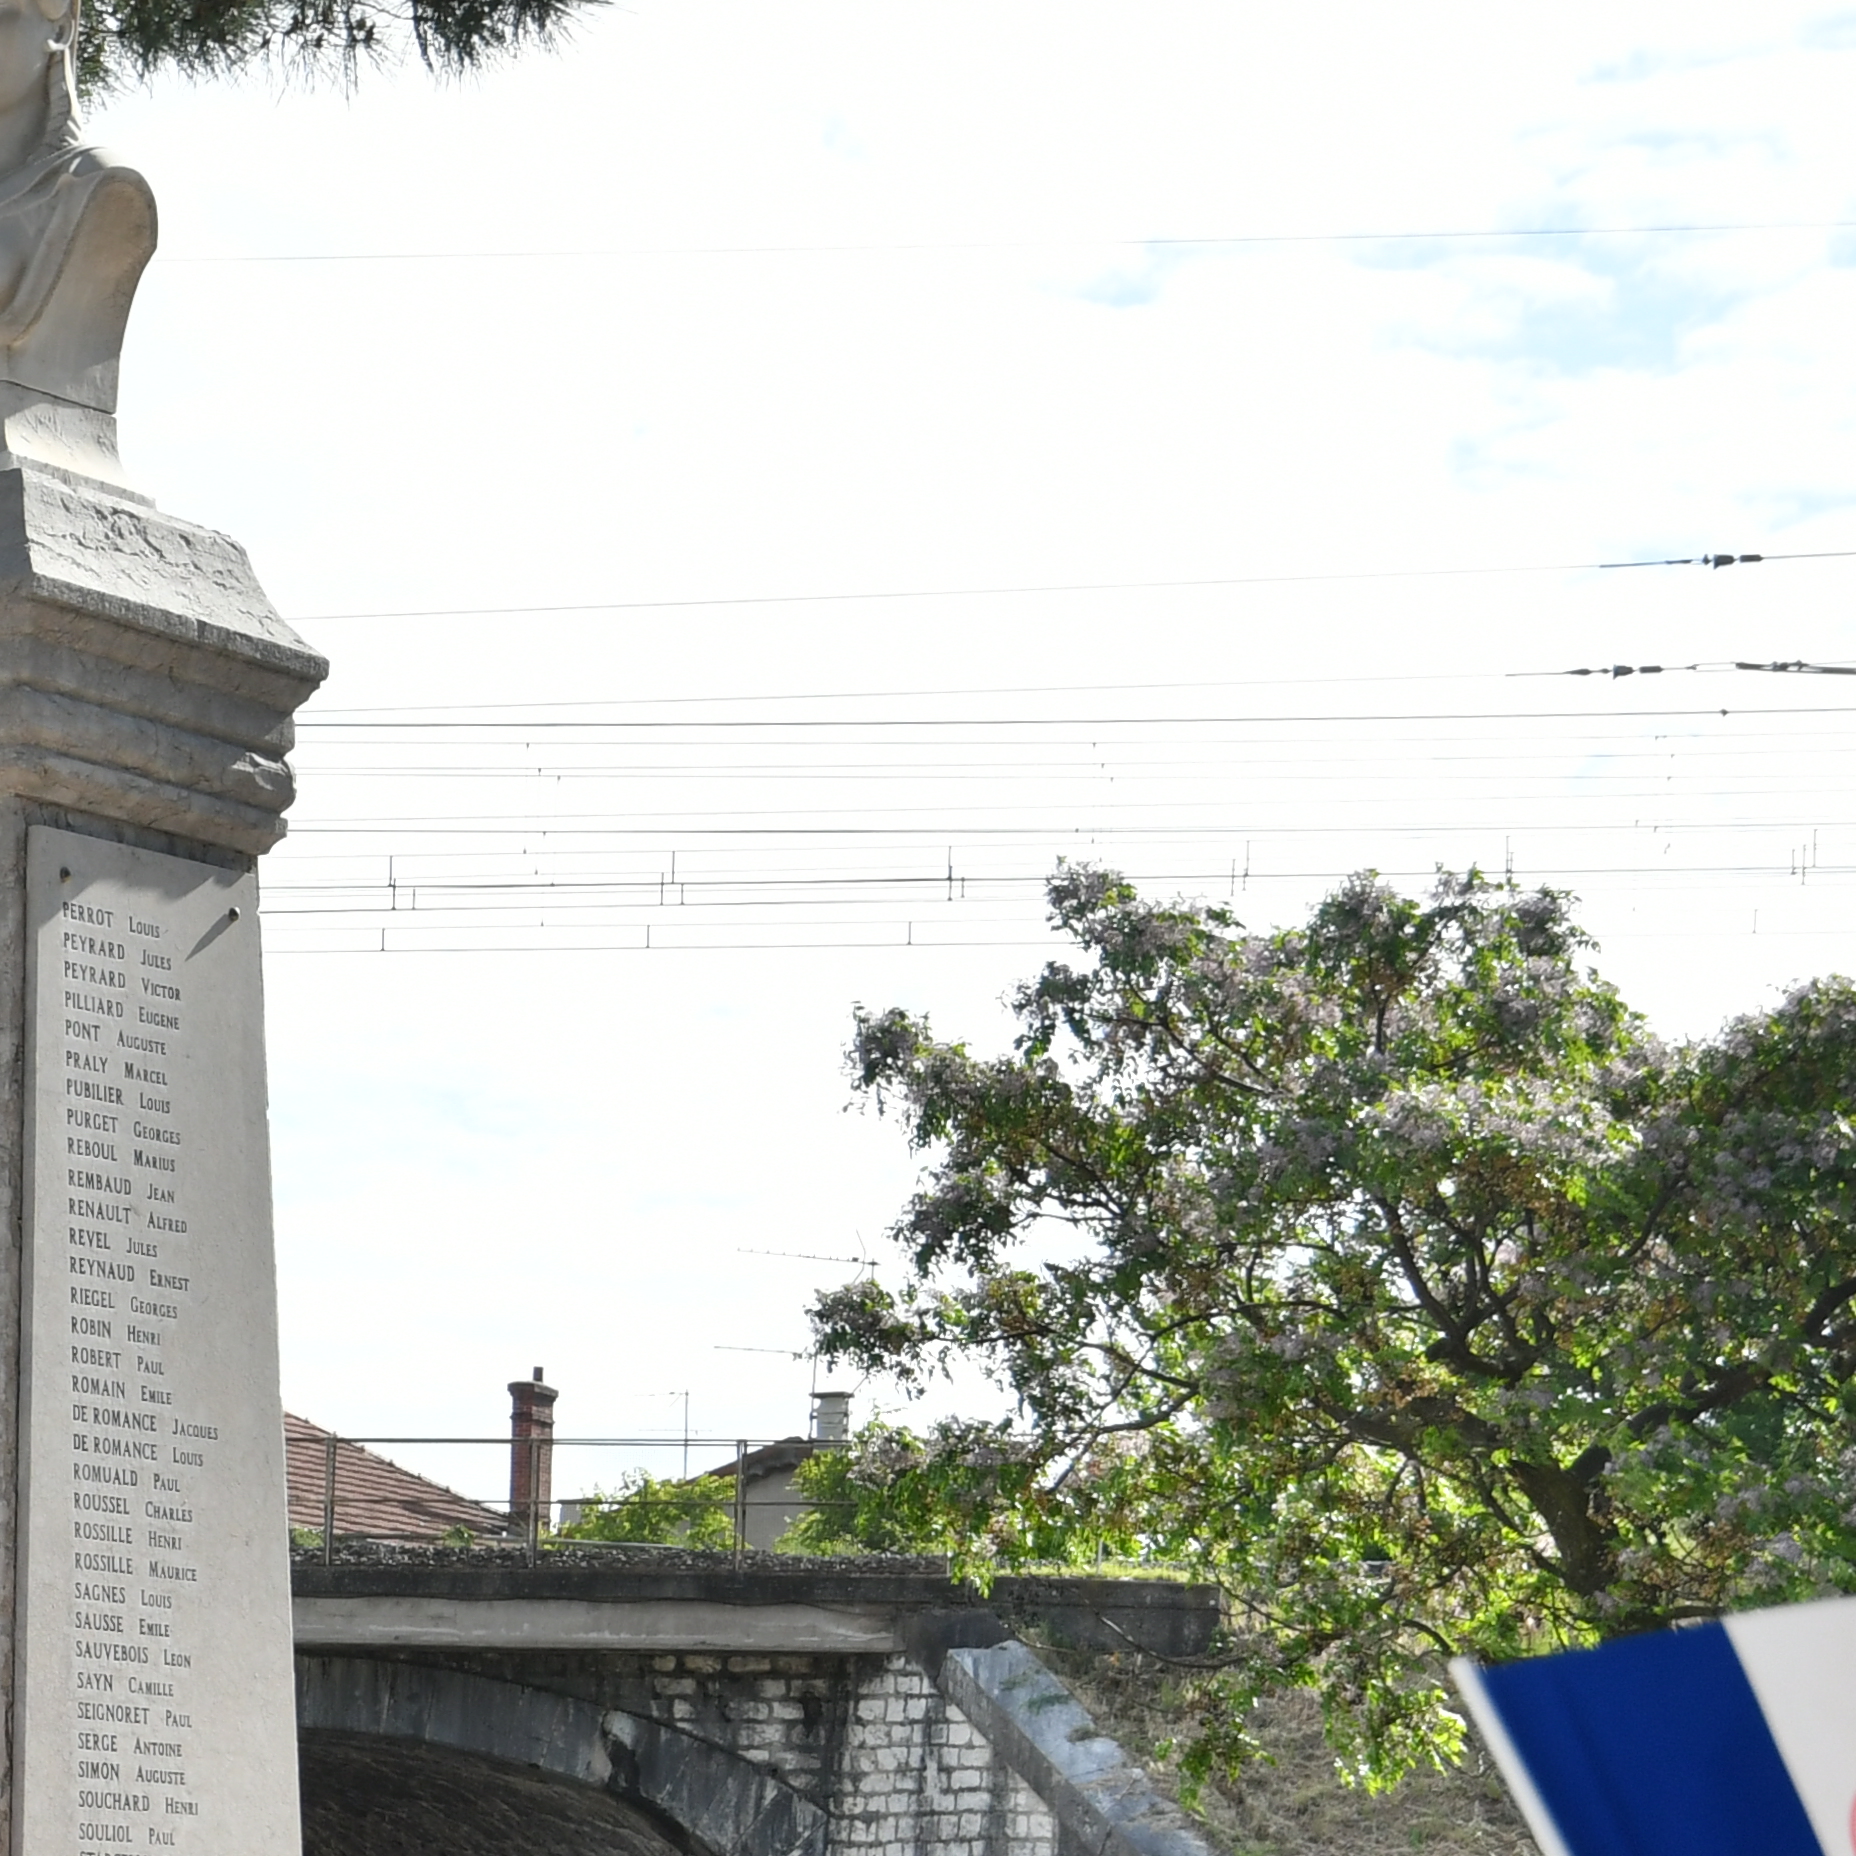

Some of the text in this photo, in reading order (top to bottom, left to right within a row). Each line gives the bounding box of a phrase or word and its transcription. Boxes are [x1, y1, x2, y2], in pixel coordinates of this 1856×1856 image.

[62, 902, 160, 938] PERROT LOUIS
[63, 932, 171, 970] PEYRARD JULES
[64, 961, 181, 1001] PEYRARD VICTOR
[65, 991, 180, 1030] PILLIARD EUGENE
[65, 1019, 166, 1055] PONT AUGUSTE
[66, 1050, 168, 1085] PRALY MARCEL
[66, 1078, 170, 1113] PUBILIER LOUIS
[67, 1108, 181, 1145] PURGET GEORGES
[67, 1137, 175, 1172] REBOUL MARIUS
[68, 1169, 174, 1203] REMBAUD JEAN
[69, 1198, 187, 1233] RENAULT ALFRED
[69, 1228, 157, 1257] REVEL JULES
[70, 1256, 189, 1291] REYNAUD ERNEST
[70, 1287, 177, 1319] RIEGEL GEORGES
[71, 1316, 160, 1345] ROBIN HENRI
[71, 1346, 164, 1375] ROBERT PAUL
[72, 1375, 172, 1405] ROMAIN EMILE
[73, 1404, 218, 1440] DE ROMANCE JACQUES
[73, 1434, 203, 1467] DE ROMANCE LOUIS
[73, 1463, 180, 1492] ROMUALD PAUL
[74, 1492, 192, 1522] ROUSSEL CHARLES
[74, 1522, 181, 1550] ROSSILLE HENRI
[75, 1552, 196, 1582] ROSSILLE MAURICE
[75, 1582, 171, 1609] SAGNES LOUIS
[75, 1612, 170, 1637] SAUSSE EMILE
[76, 1640, 191, 1668] SAUVEBOIS LEON
[77, 1672, 174, 1697] SAYN CAMILLE
[78, 1702, 192, 1728] SEIGNORET PAUL
[78, 1732, 182, 1757] SERGE ANTOINE
[78, 1761, 186, 1785] SIMON AUGUSTE
[78, 1791, 198, 1815] SOUCHARD HENRI
[79, 1823, 175, 1846] SOULIOL PAUL
